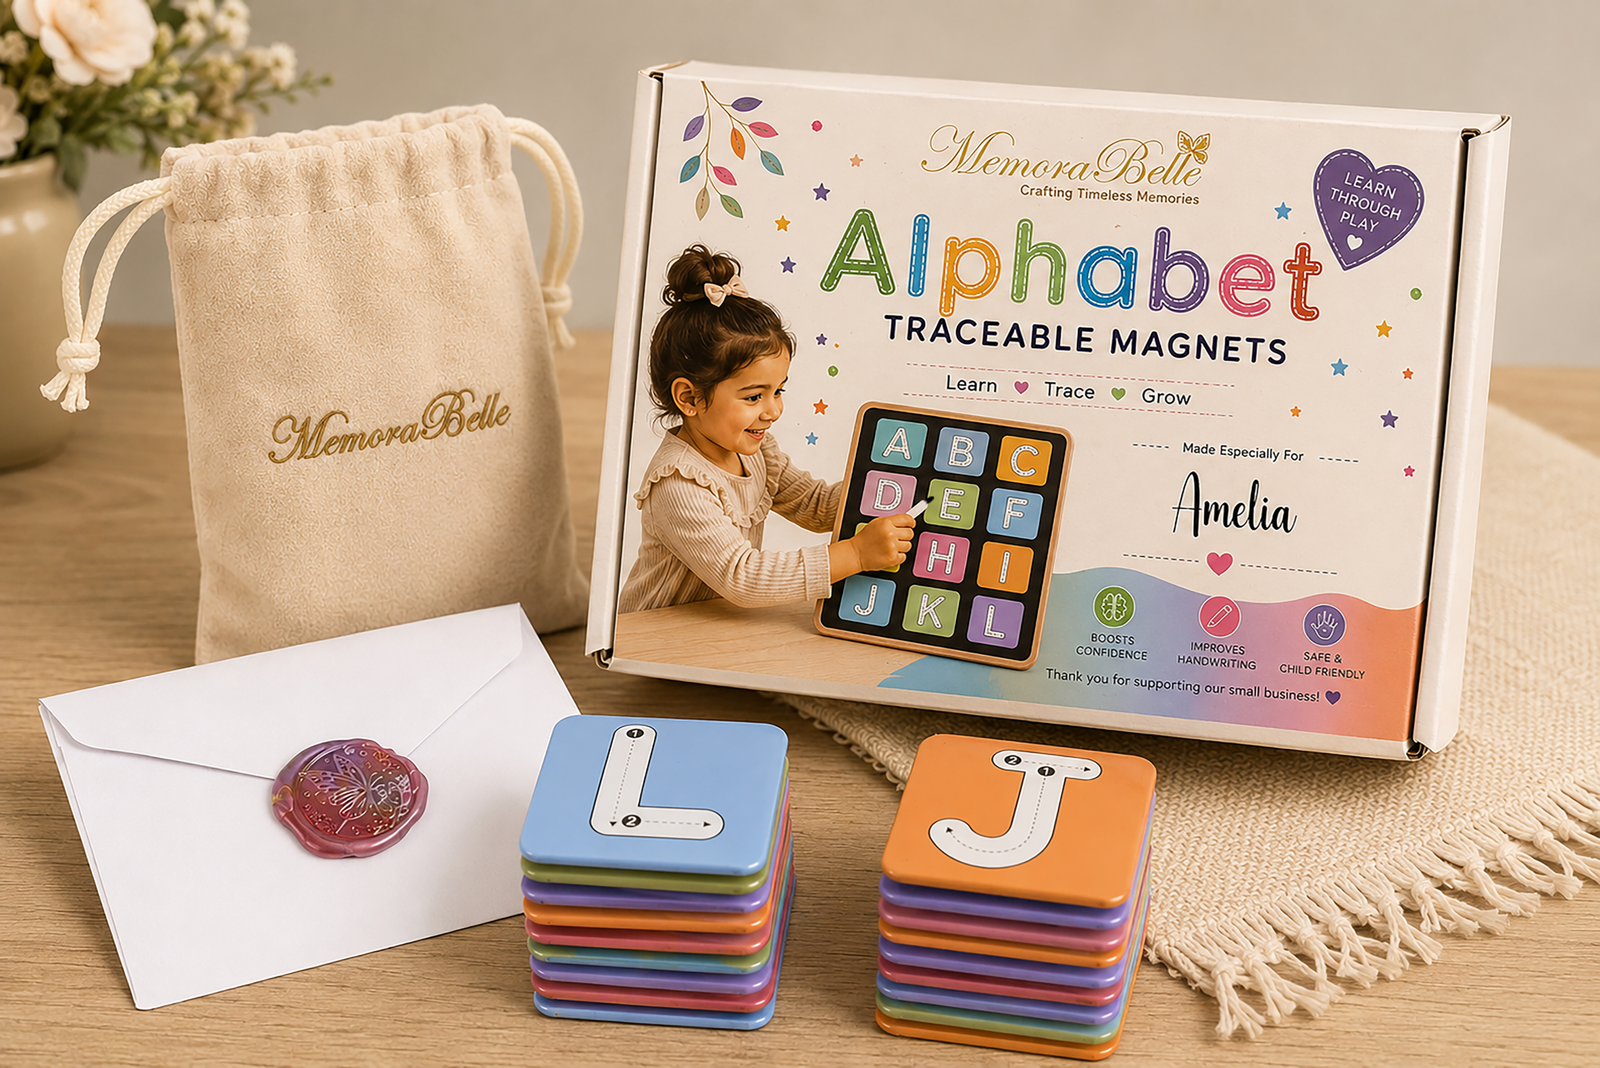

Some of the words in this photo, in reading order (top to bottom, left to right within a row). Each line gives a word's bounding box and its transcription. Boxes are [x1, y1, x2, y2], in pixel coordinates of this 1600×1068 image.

[921, 124, 1204, 188] MemoraBelle
[1020, 184, 1073, 201] Crafting
[1077, 188, 1133, 203] Timeless
[1136, 190, 1200, 206] Memories
[1343, 171, 1397, 199] LEARN
[1329, 187, 1402, 222] THROUGH
[1339, 211, 1379, 234] PLAY
[820, 208, 1323, 324] Alphabet
[884, 314, 1094, 353] TRACEABLE
[1110, 328, 1287, 365] MAGNETS
[945, 375, 997, 394] Learn
[1044, 381, 1095, 400] Trace
[1141, 388, 1192, 406] Grow
[268, 388, 511, 464] MemoraBelle
[882, 427, 911, 461] A
[948, 435, 974, 467] B
[1182, 443, 1216, 456] Made
[1219, 445, 1280, 462] Especially
[1283, 449, 1304, 461] For
[1010, 445, 1039, 477] C
[873, 478, 902, 511] D
[939, 487, 965, 521] E
[1172, 471, 1298, 537] Amelia
[1003, 497, 1028, 529] F
[926, 540, 955, 575] H
[999, 551, 1009, 584] I
[854, 583, 878, 617] J
[917, 594, 945, 629] K
[983, 604, 1005, 639] L
[1076, 646, 1148, 661] CONFIDENCE
[1091, 633, 1135, 646] BOOSTS
[1190, 642, 1245, 656] IMPROVES
[1177, 654, 1257, 670] HANDWRITING
[1279, 663, 1311, 676] CHILD
[1314, 666, 1365, 680] FRIENDLY
[1303, 651, 1331, 663] SAFE
[1333, 653, 1342, 664] &
[1045, 667, 1083, 683] Thank
[1086, 672, 1110, 687] you
[1113, 673, 1131, 686] for
[1133, 676, 1201, 695] supporting
[1204, 683, 1225, 695] our
[1228, 683, 1260, 699] small
[1263, 685, 1320, 703] business!
[589, 724, 725, 840] L
[929, 750, 1102, 868] J
